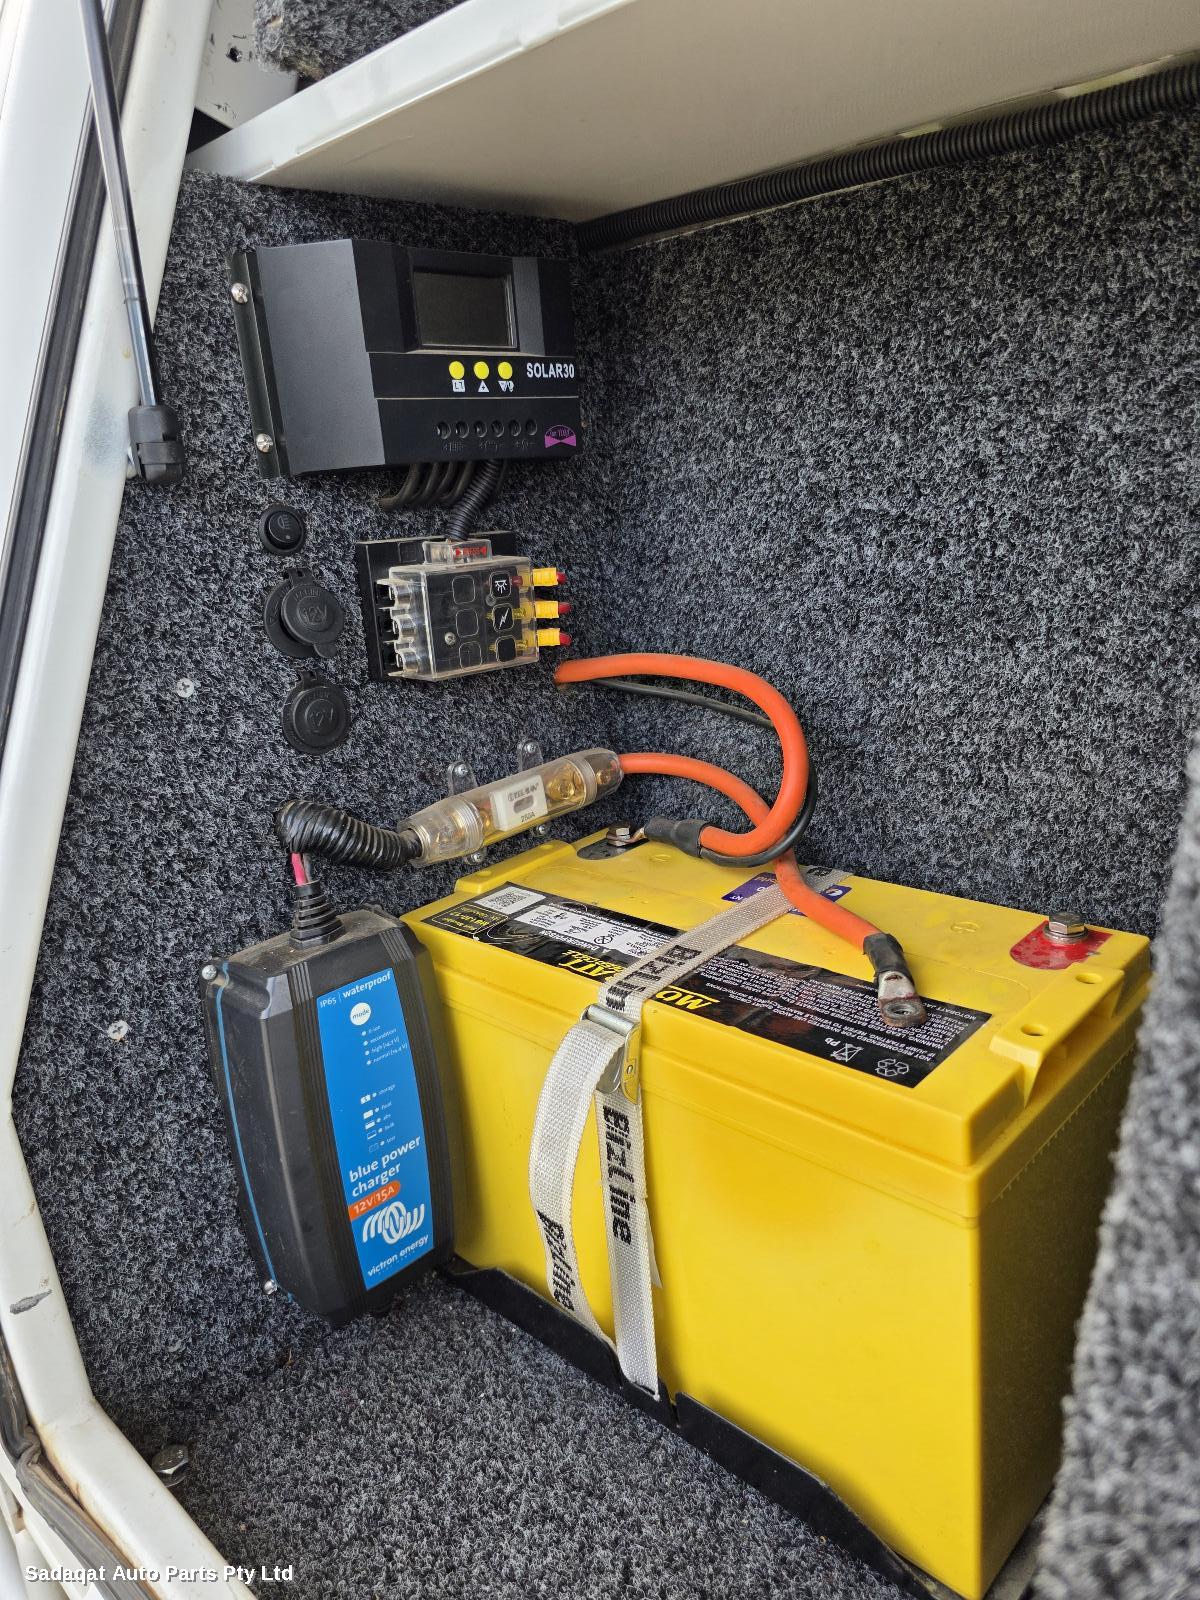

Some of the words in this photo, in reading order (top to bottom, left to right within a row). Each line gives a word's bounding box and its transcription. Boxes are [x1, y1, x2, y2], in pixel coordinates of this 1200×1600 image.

[526, 362, 575, 379] SOLAR30
[319, 997, 337, 1008] IP65
[342, 970, 392, 999] waterproof
[352, 1008, 370, 1020] mode
[773, 1008, 793, 1016] AVOID
[829, 1007, 848, 1015] FROM
[937, 1007, 975, 1019] MOTOBATT
[804, 1013, 831, 1024] VEHICLE
[830, 1012, 867, 1025] BATTERIES
[807, 1019, 840, 1031] INVERTED
[843, 1026, 866, 1035] REFER
[870, 1020, 914, 1035] CIGARETTES
[885, 1029, 905, 1037] LEAD
[916, 1033, 947, 1044] LIGHTED
[824, 1037, 839, 1047] Pb
[857, 1035, 913, 1055] RECOMMENDED
[914, 1053, 930, 1061] NOT
[349, 1159, 379, 1183] blue
[381, 1135, 421, 1168] power
[351, 1163, 401, 1197] charger
[367, 1253, 399, 1277] victron
[399, 1233, 430, 1257] energy
